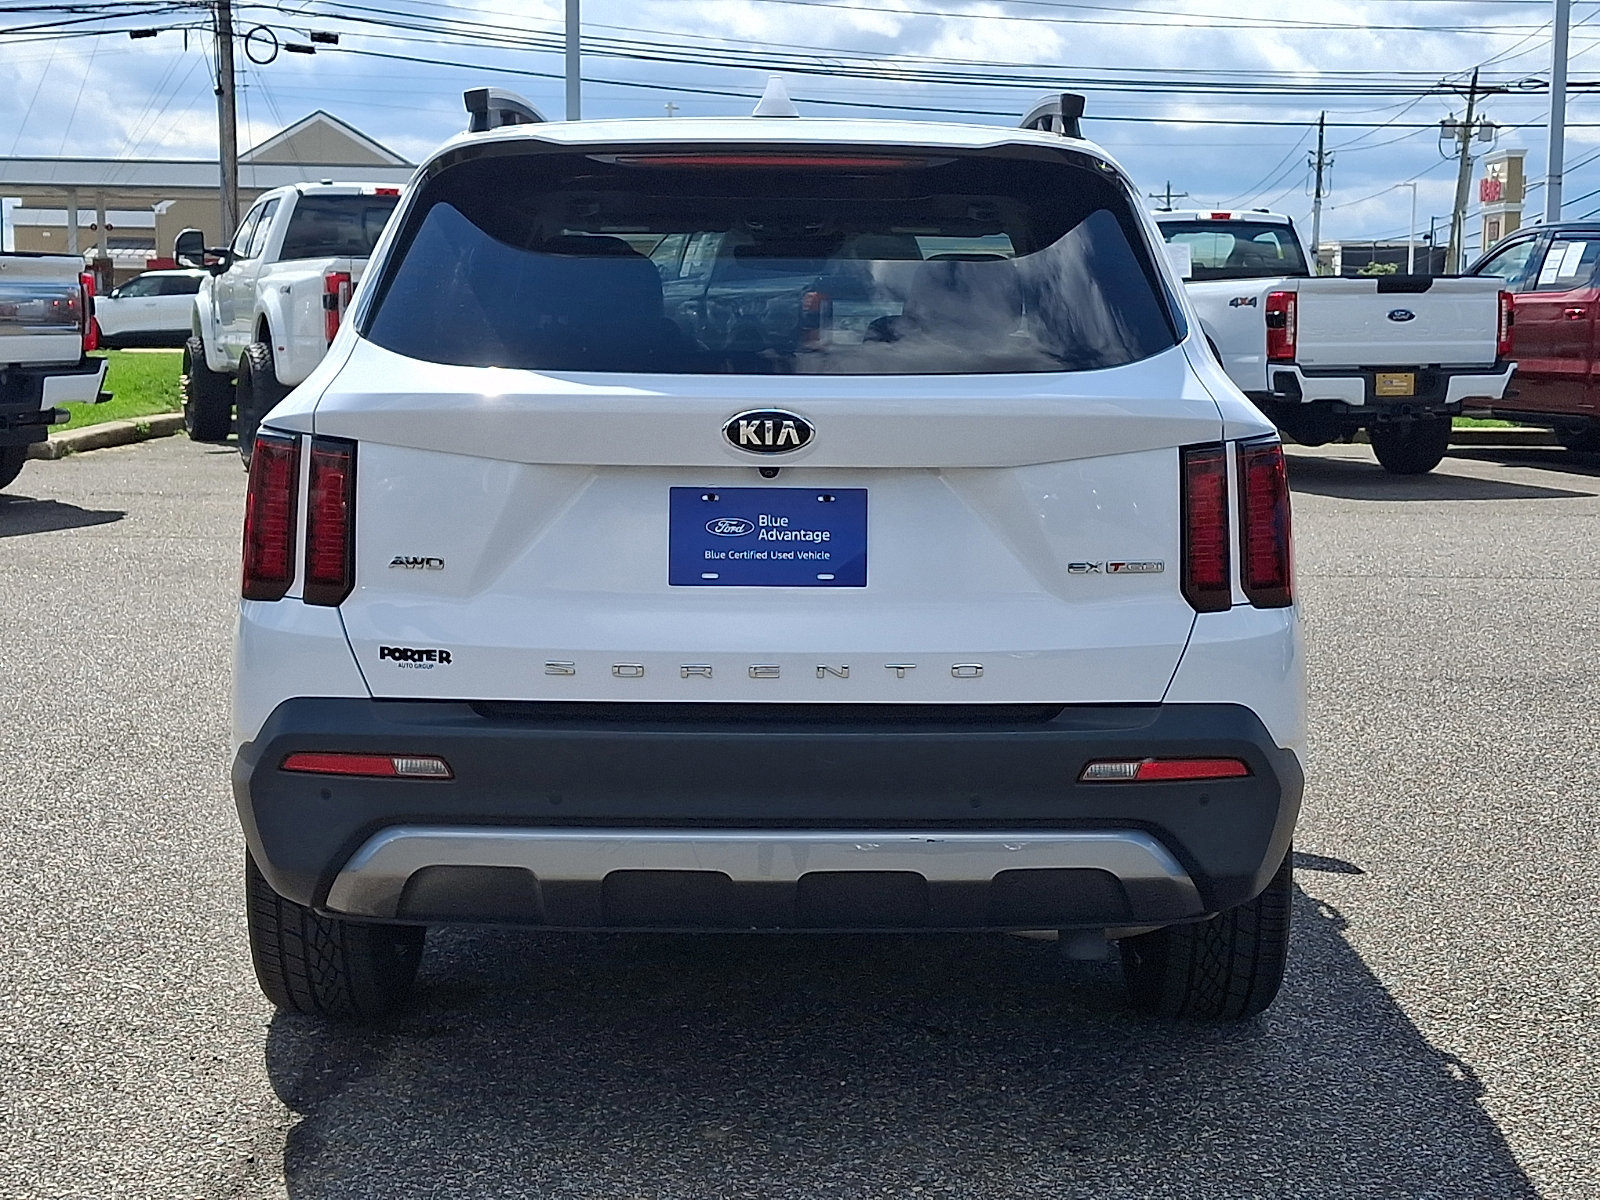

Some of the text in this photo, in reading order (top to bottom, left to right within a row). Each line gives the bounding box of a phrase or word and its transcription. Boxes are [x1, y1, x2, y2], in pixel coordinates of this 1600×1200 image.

[739, 420, 801, 445] KIA
[714, 520, 746, 533] Ford
[758, 515, 789, 527] Blue
[758, 528, 831, 543] Advantage
[704, 550, 831, 560] Blue Certified Used Vehicle
[389, 556, 445, 570] AWD
[1068, 561, 1103, 574] EX
[379, 646, 453, 664] PORTER
[545, 660, 984, 679] SORENTO
